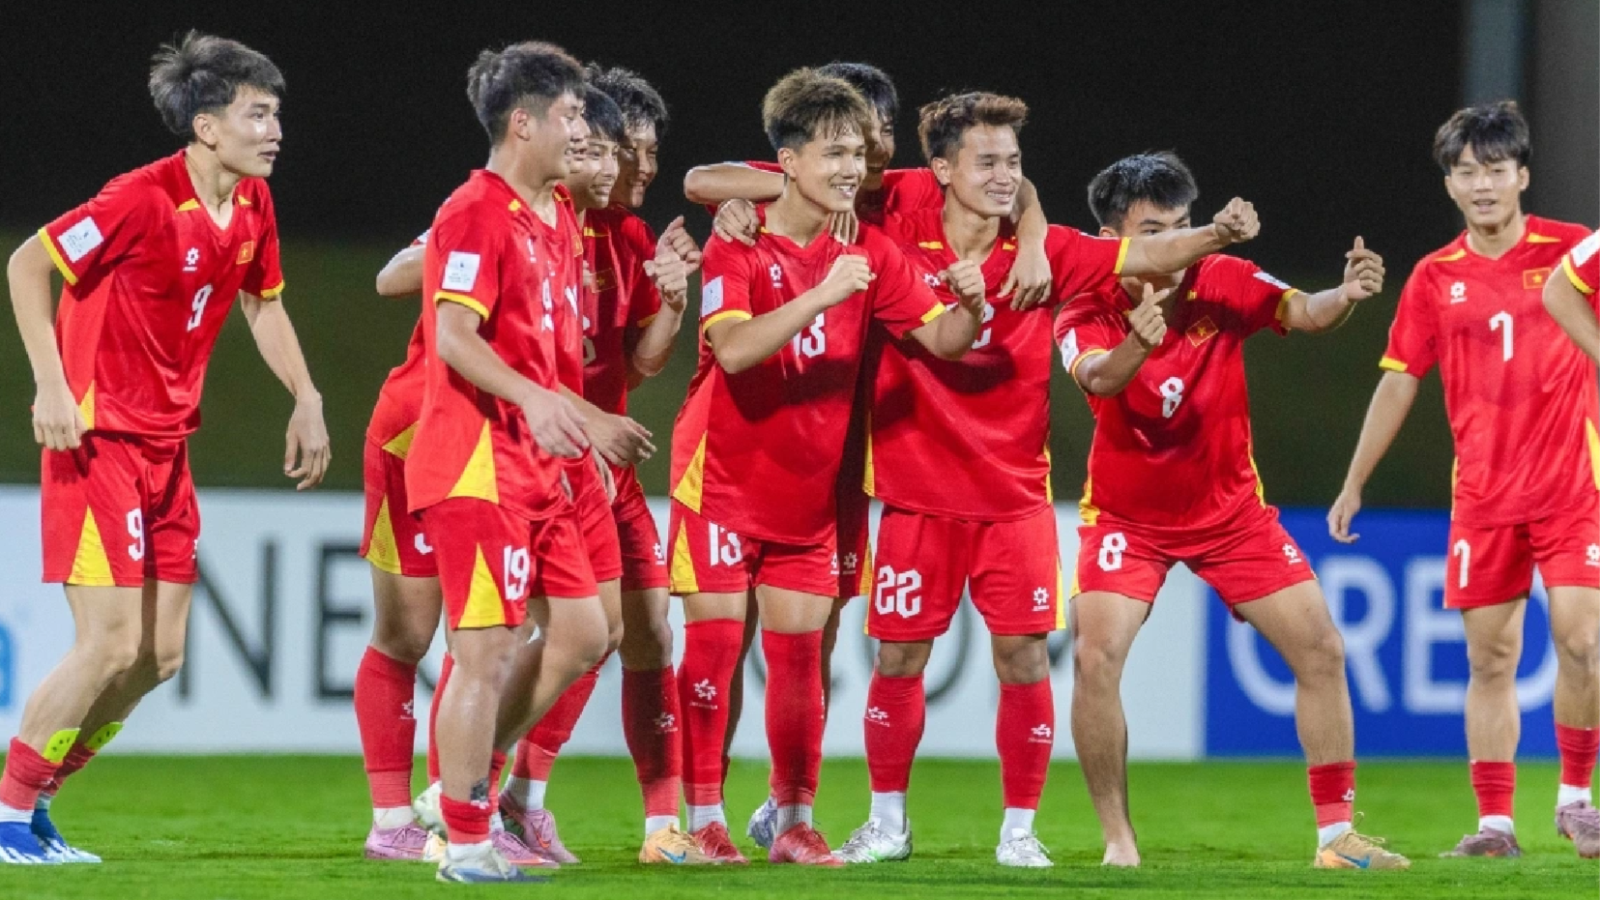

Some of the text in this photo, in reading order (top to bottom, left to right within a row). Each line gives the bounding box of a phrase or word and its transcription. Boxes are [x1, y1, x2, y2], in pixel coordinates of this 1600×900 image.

[186, 284, 213, 332] 9
[1159, 376, 1185, 418] 8
[126, 507, 145, 561] 9
[708, 521, 743, 566] 13
[1098, 532, 1128, 572] 8
[503, 544, 531, 601] 19
[874, 564, 923, 620] 22
